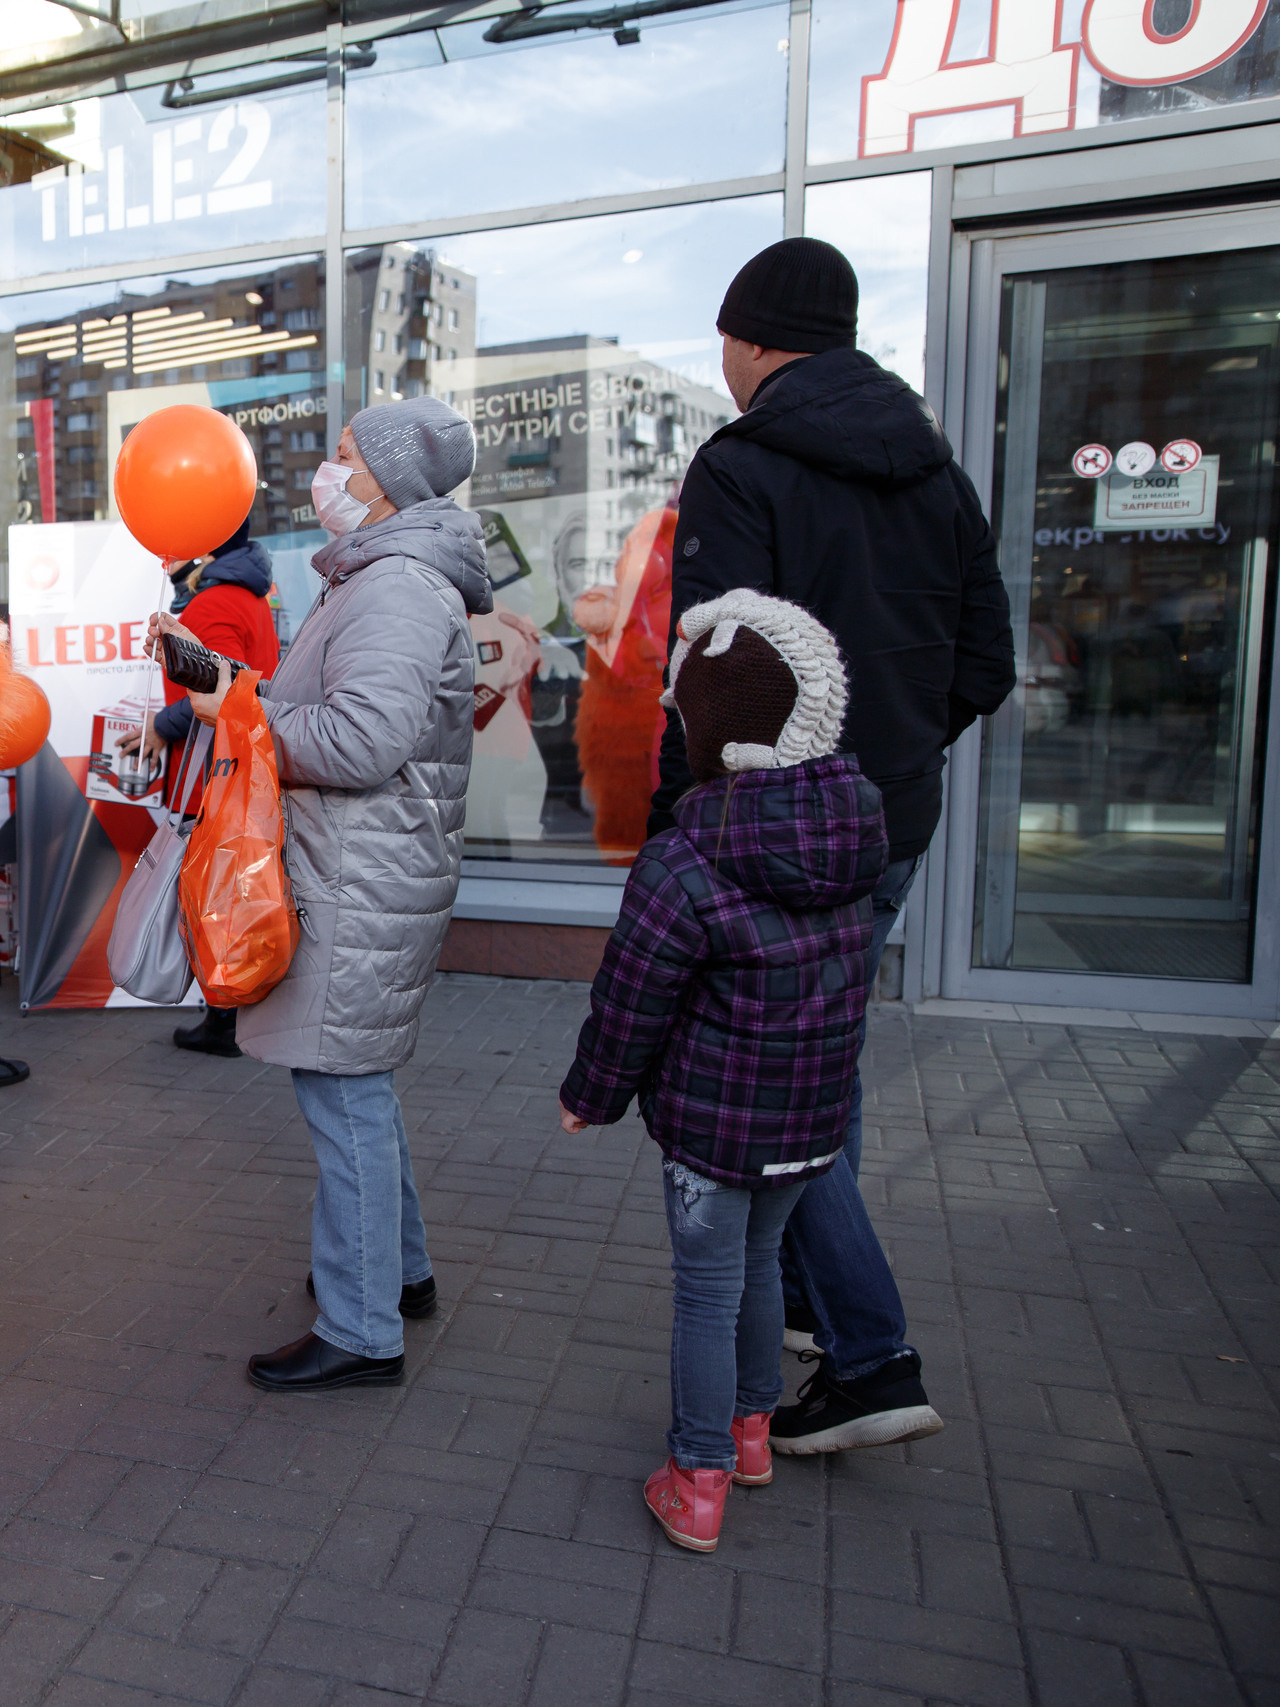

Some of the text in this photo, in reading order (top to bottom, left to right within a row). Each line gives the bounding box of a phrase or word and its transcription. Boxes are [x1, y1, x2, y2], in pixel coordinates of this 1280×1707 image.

[32, 101, 273, 242] TELE2
[227, 397, 328, 427] АРТФОНОВ
[475, 415, 562, 449] НУТРИ
[1133, 477, 1180, 490] ВХОД
[291, 502, 318, 523] TEL
[1121, 500, 1190, 511] ЗАПРЕЩЕН
[27, 621, 148, 667] LEBE
